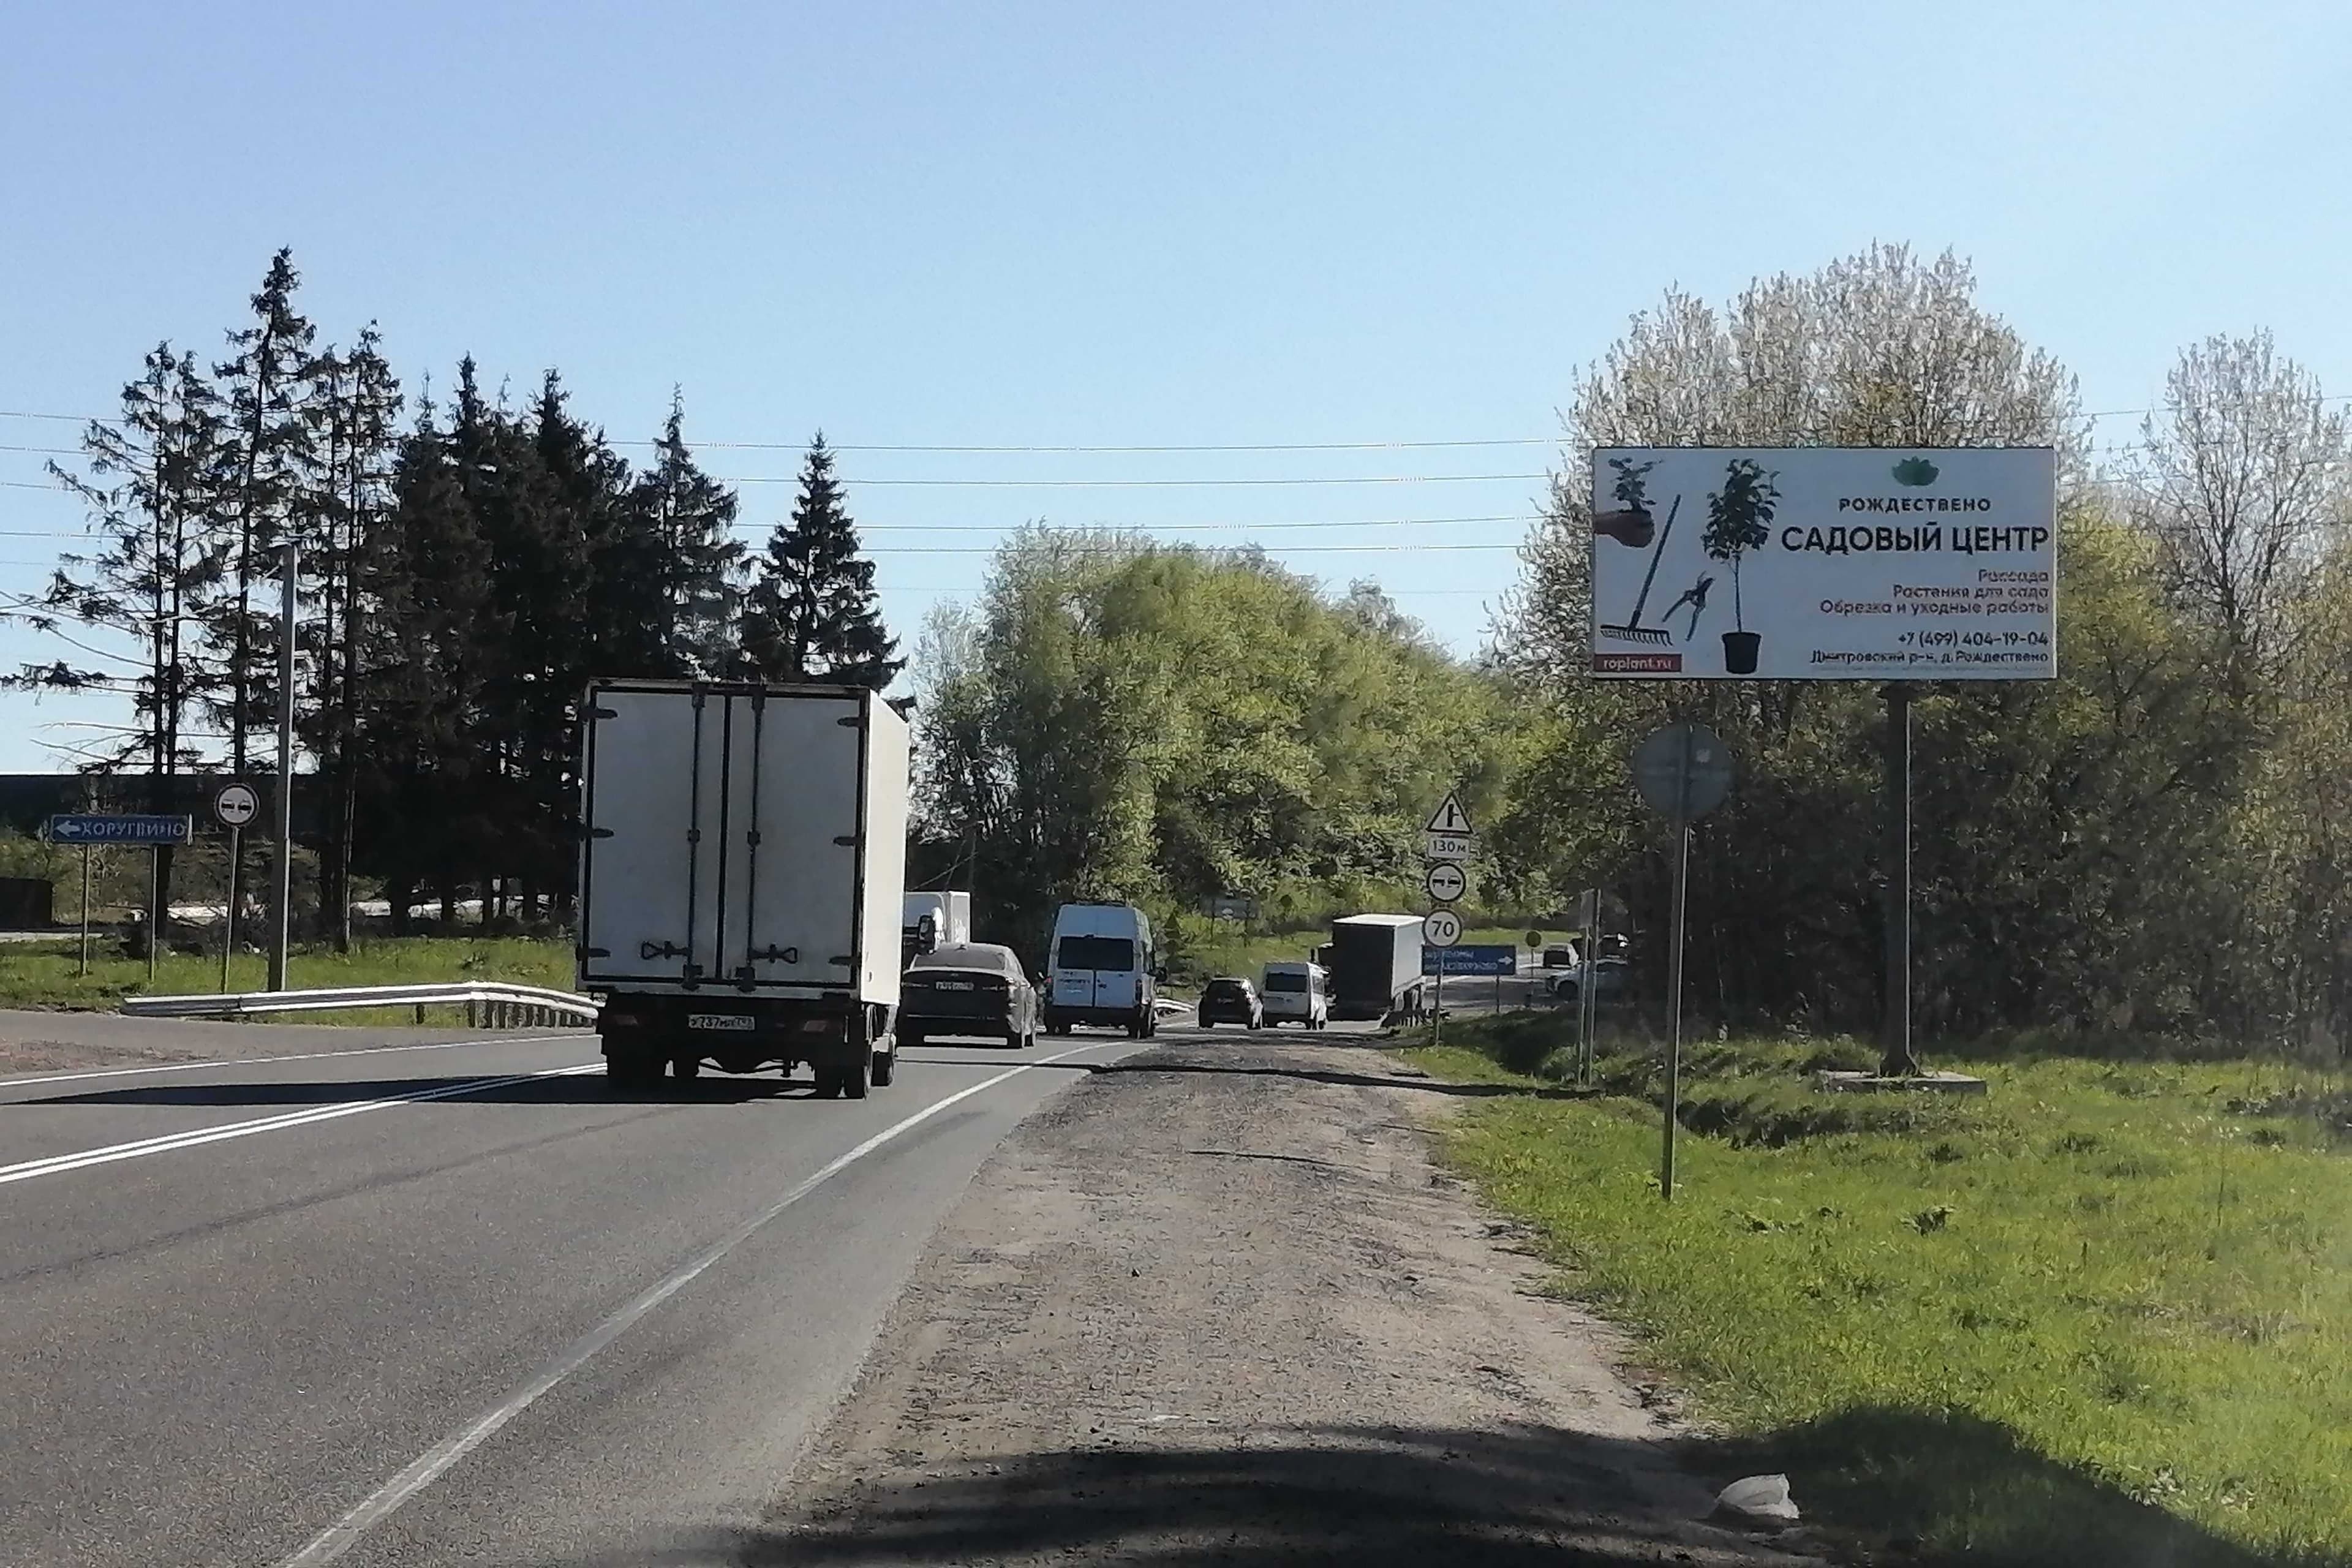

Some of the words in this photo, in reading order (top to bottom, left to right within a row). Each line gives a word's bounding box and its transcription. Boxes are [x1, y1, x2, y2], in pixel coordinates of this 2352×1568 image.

[1839, 497, 1991, 514] РОЖДЕСТВЕНО
[1781, 521, 1942, 556] САДОВЫЙ
[1952, 526, 2049, 556] ЦЕНТР
[1893, 585, 1969, 598] Растения
[2008, 588, 2048, 599] сада
[1820, 600, 1892, 616] Обрезка
[1896, 603, 1906, 613] и
[1911, 603, 1982, 616] уходные
[1986, 600, 2048, 616] работы
[1899, 631, 1915, 646] +7
[1918, 630, 1958, 648] (499)
[1962, 631, 2048, 646] 404-19-04
[1604, 657, 1672, 671] roplant.ru
[81, 821, 187, 837] ХОРУГВИНО
[1433, 840, 1455, 853] 130
[1432, 921, 1455, 937] 70
